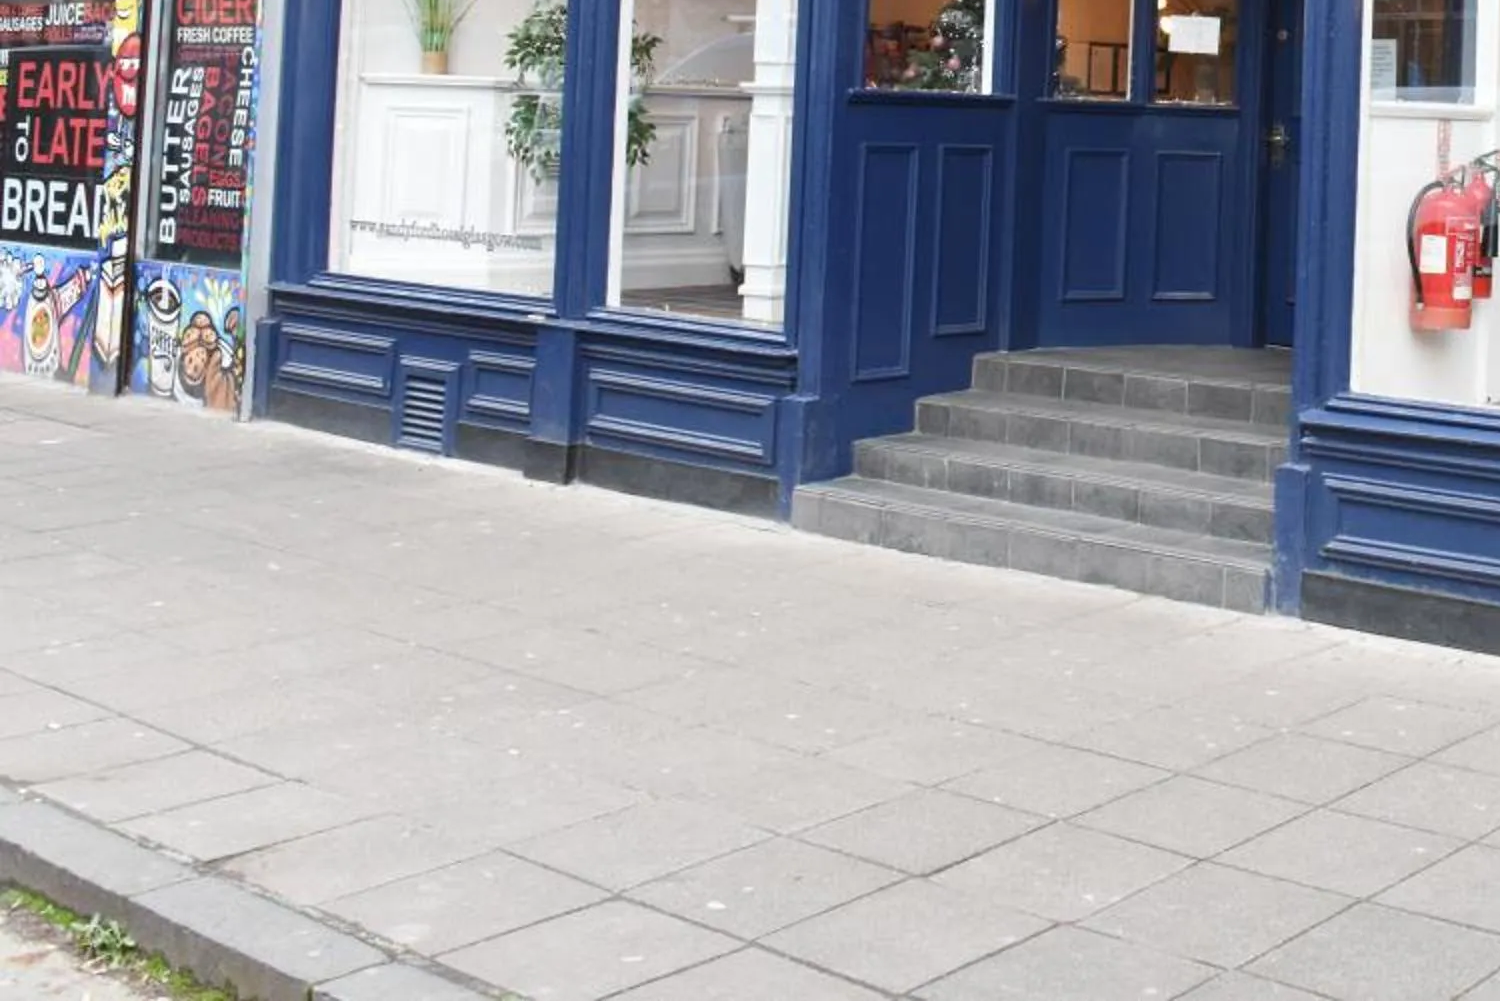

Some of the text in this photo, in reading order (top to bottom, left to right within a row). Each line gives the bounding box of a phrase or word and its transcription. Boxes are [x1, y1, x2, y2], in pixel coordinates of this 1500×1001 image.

[45, 3, 85, 25] JUICE
[177, 26, 254, 43] FRESH COFFEE
[17, 61, 113, 111] EARLY
[229, 46, 255, 167] CHEESE
[15, 115, 30, 163] TO
[32, 116, 106, 168] LATE
[159, 67, 191, 244] BUTTER
[179, 67, 205, 203] SAUSAGES
[192, 66, 220, 208] BAGELS
[207, 189, 242, 208] FRUIT
